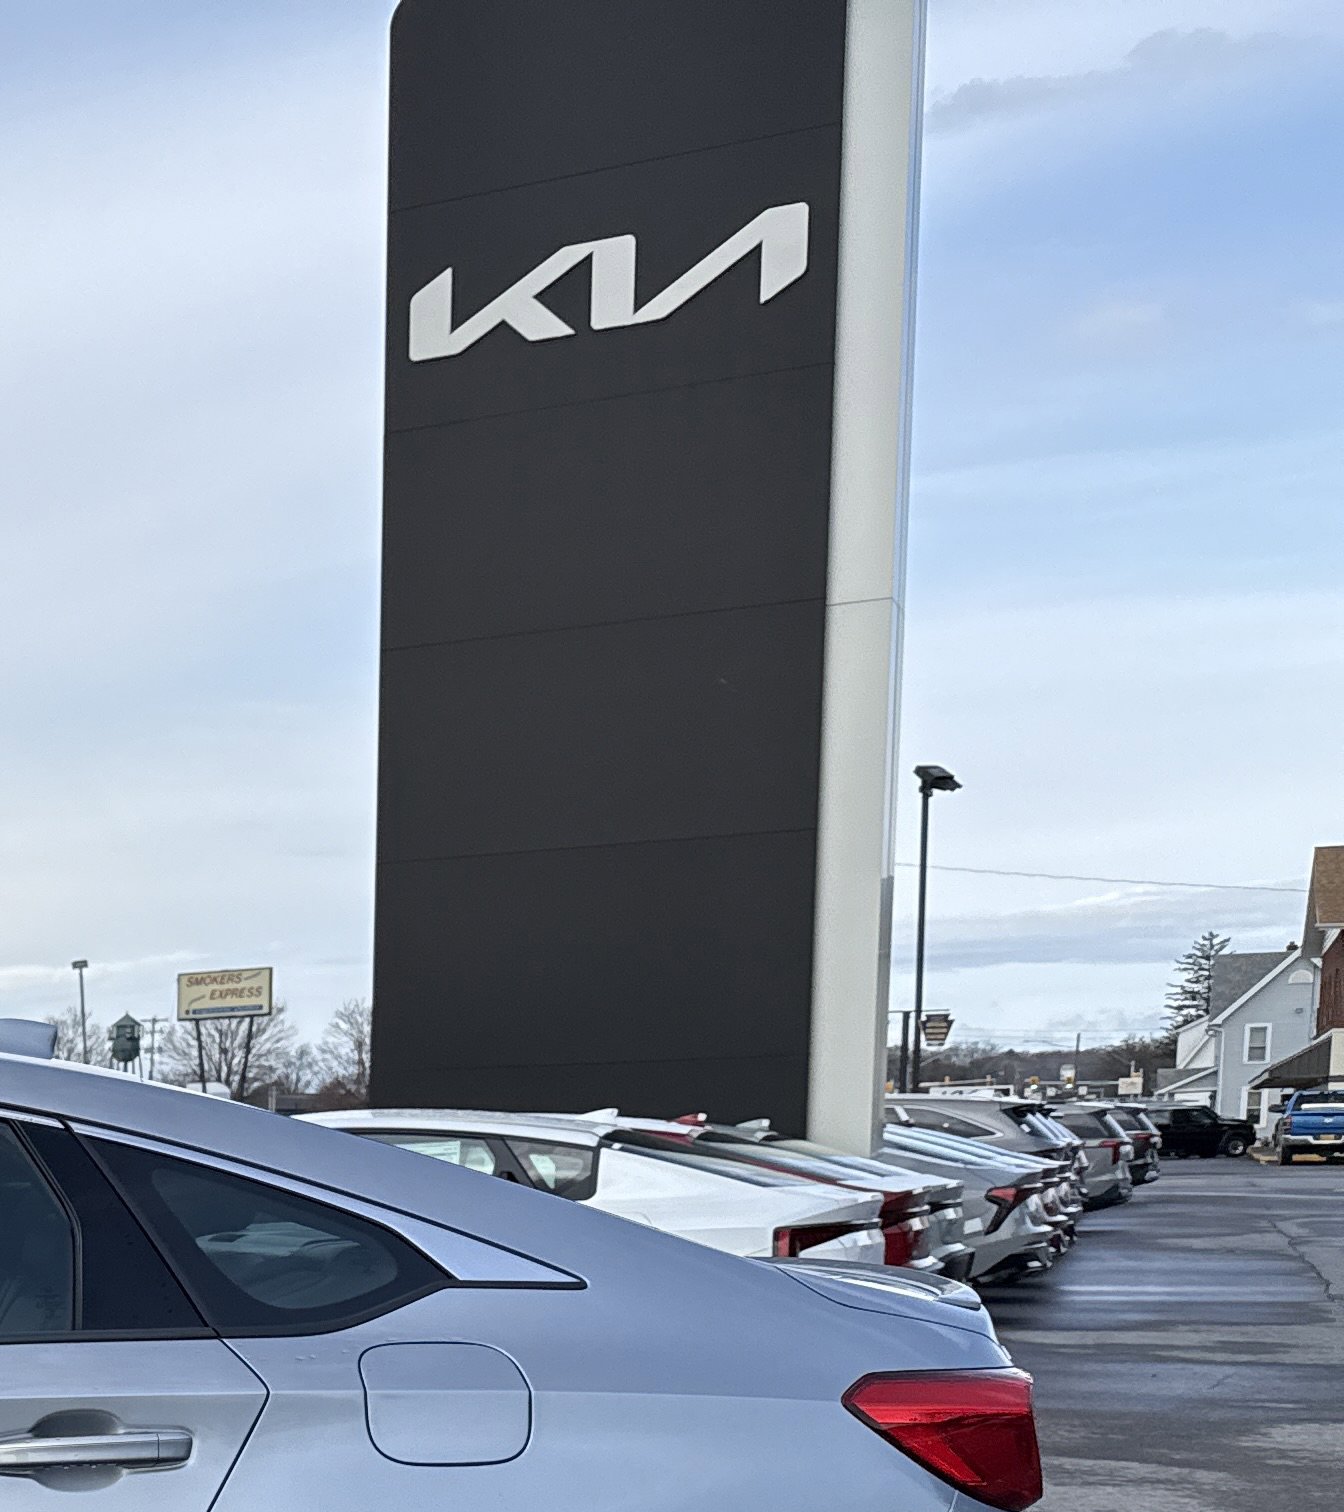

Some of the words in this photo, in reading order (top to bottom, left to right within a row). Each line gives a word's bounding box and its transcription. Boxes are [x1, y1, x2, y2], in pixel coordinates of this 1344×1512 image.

[409, 202, 809, 362] KIA
[186, 973, 243, 988] SMOKERS
[209, 986, 263, 1000] EXPRESS
